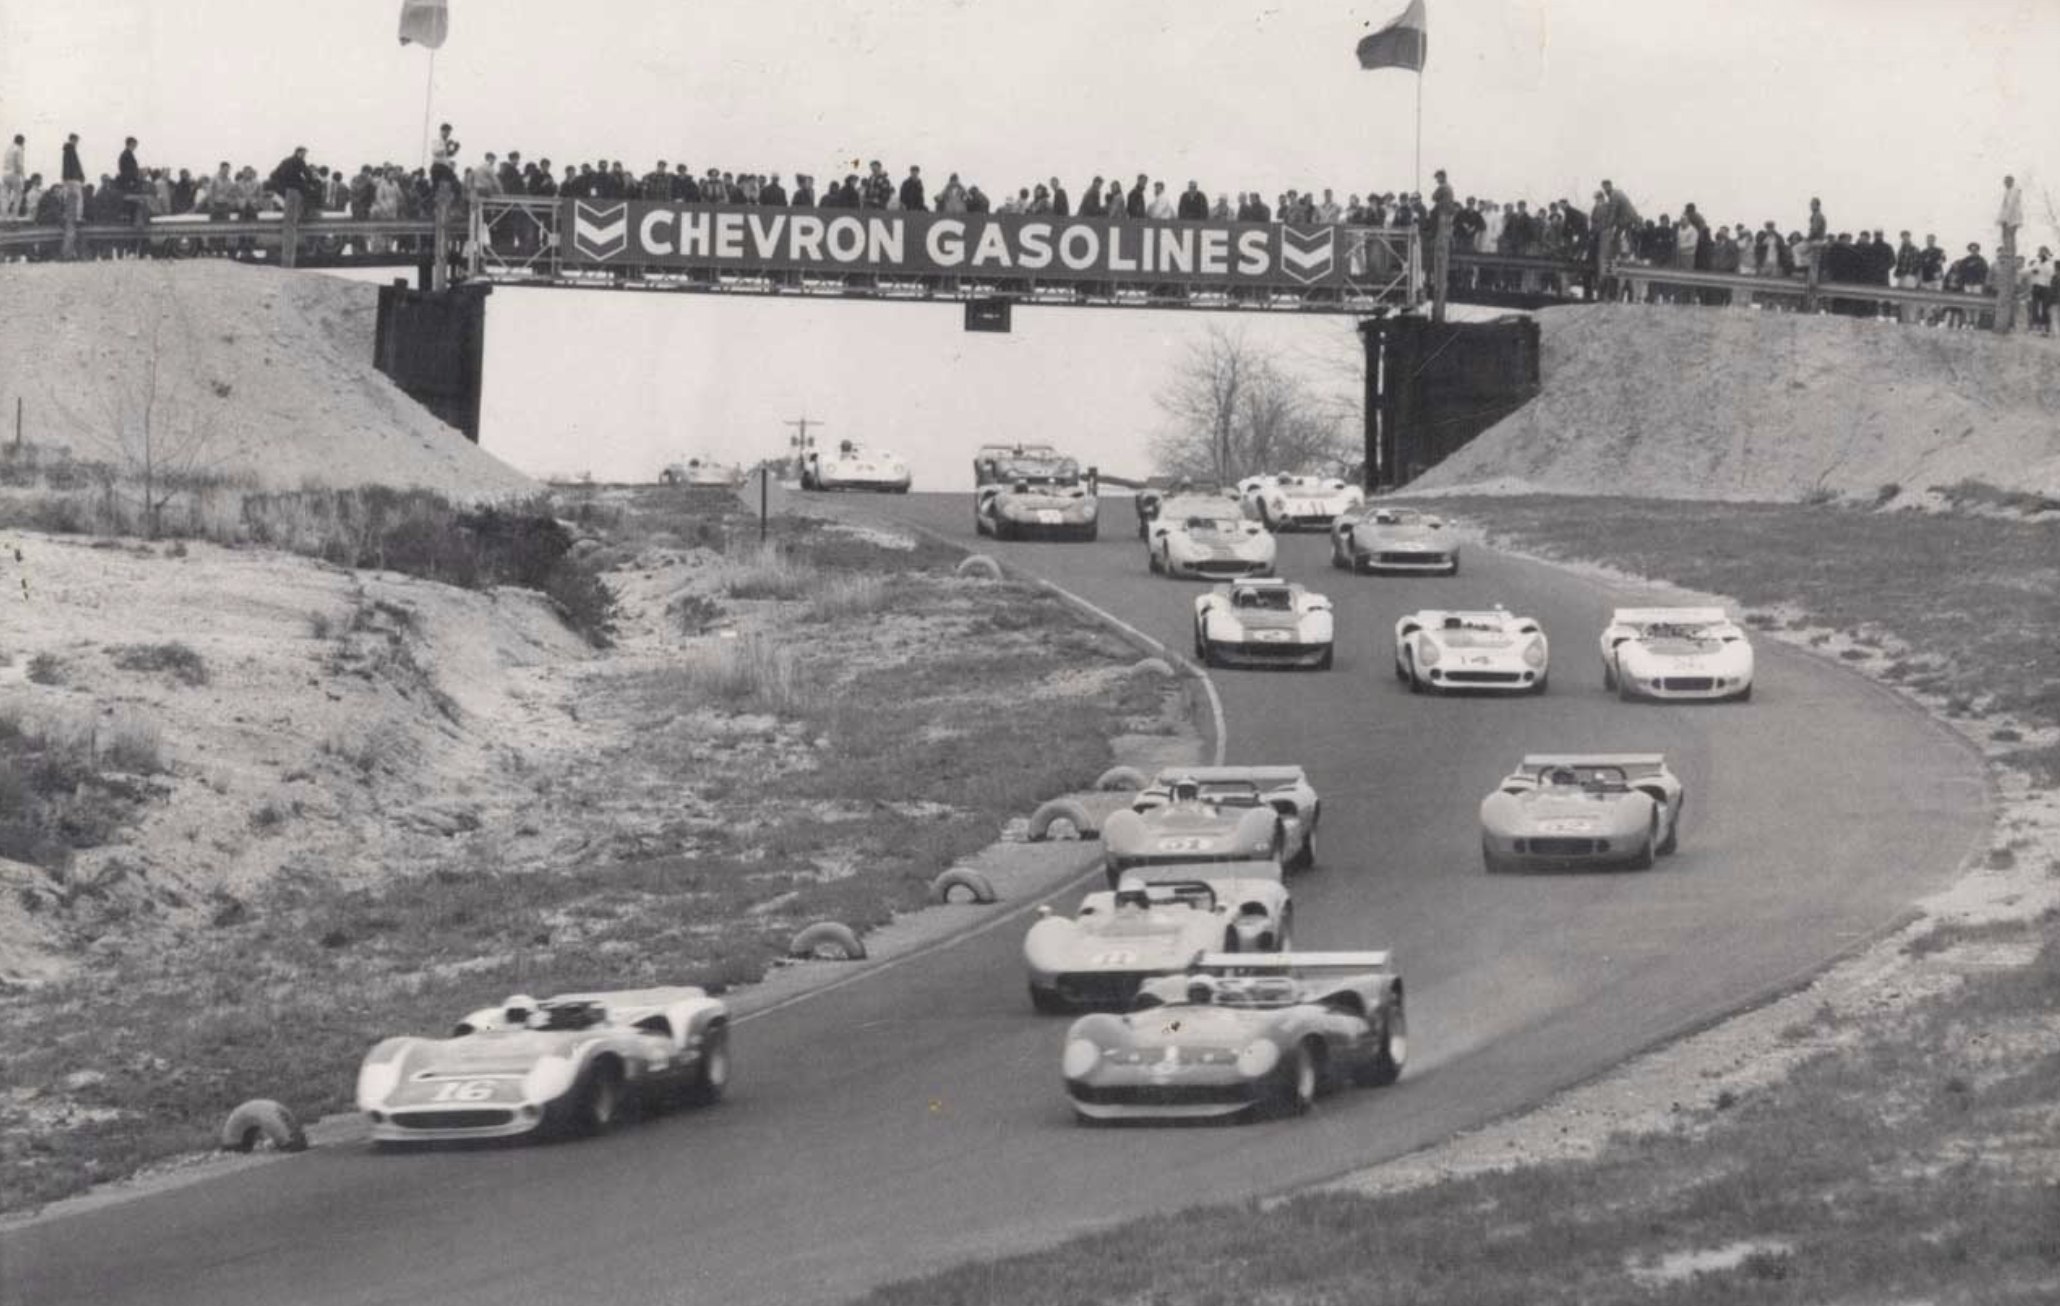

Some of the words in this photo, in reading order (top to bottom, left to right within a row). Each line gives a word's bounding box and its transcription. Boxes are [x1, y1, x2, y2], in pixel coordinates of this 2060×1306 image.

[640, 209, 904, 263] CHEVRON
[926, 219, 1270, 275] GASOLINES
[434, 1081, 494, 1100] 16
